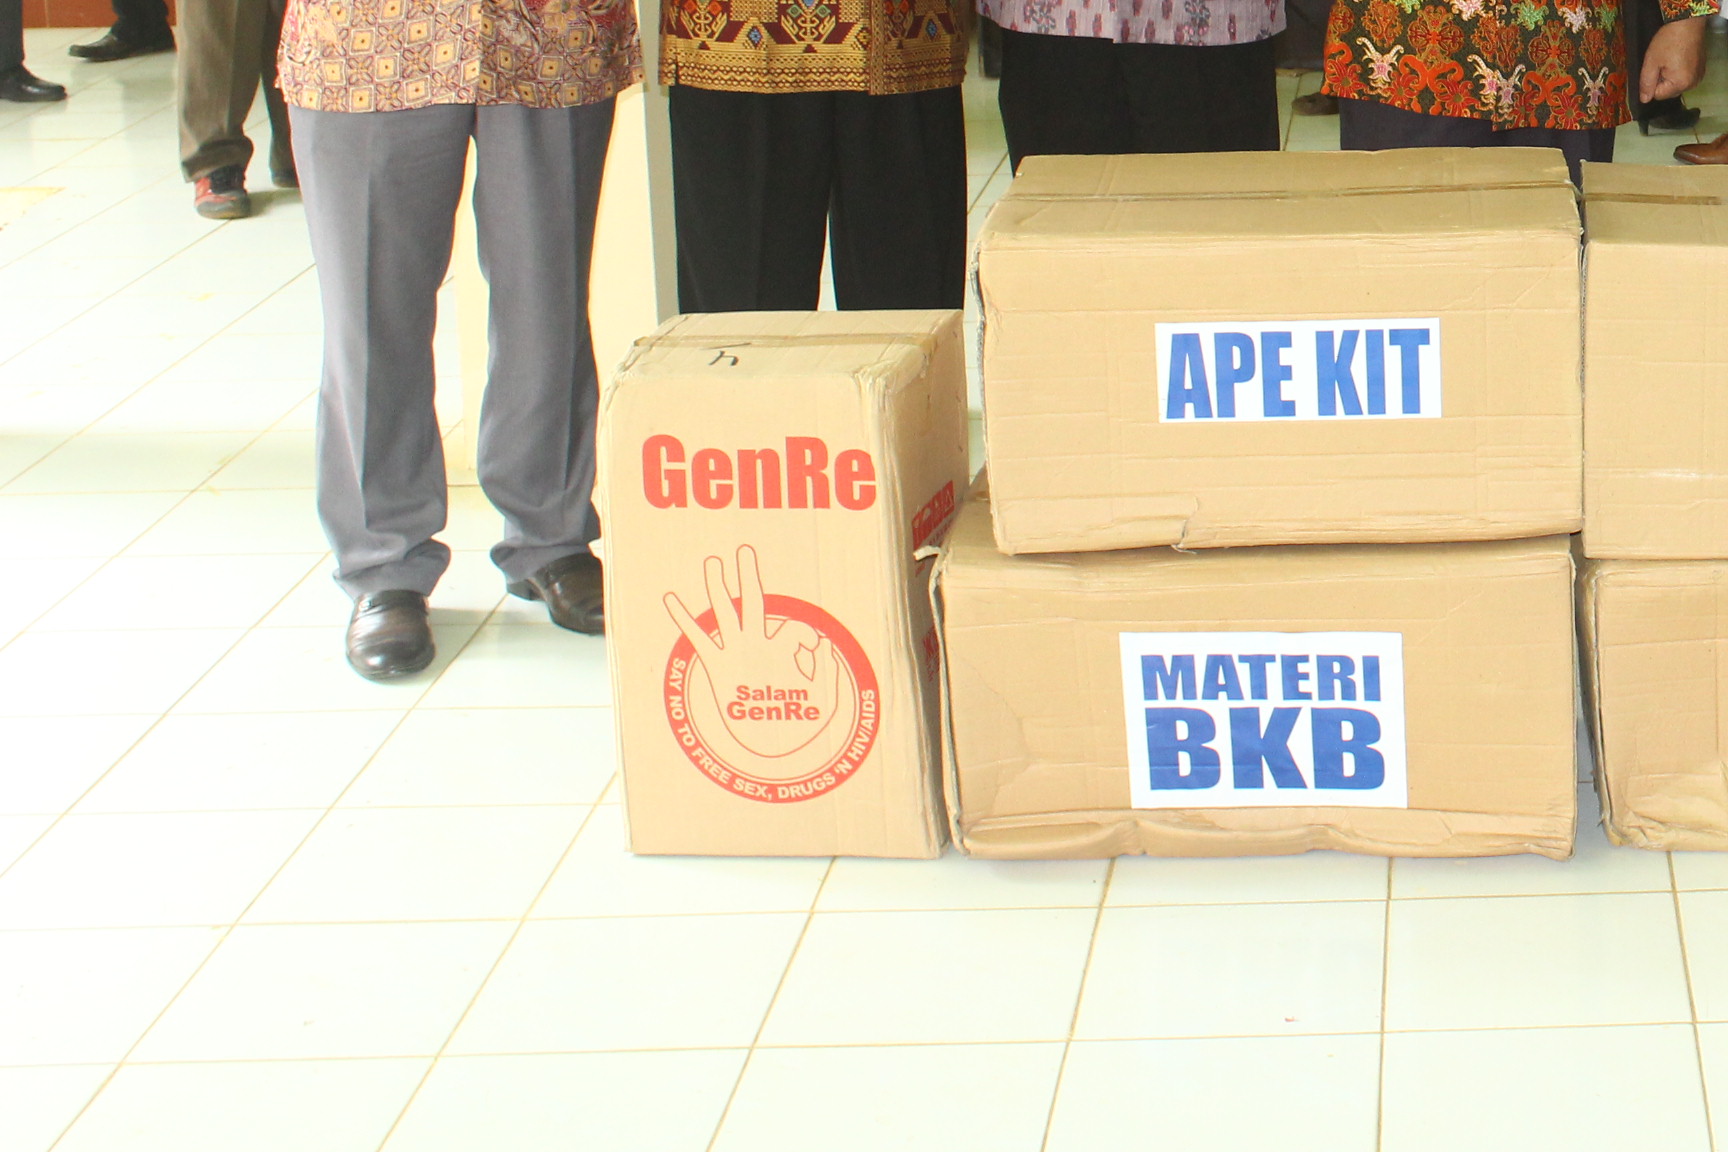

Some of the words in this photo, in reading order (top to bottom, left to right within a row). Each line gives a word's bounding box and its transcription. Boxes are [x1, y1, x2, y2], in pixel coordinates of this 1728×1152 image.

[1167, 332, 1295, 419] APE
[1316, 329, 1429, 416] KIT
[643, 435, 876, 510] GenRe
[669, 657, 686, 692] SAY
[1141, 655, 1381, 702] MATERI
[669, 696, 685, 721] NO
[736, 685, 808, 701] Salam
[727, 701, 820, 720] GenRe
[847, 689, 875, 762] HIV/AIDS
[677, 723, 696, 747] TO
[1145, 708, 1385, 791] BKB
[692, 750, 731, 784] FREE
[733, 778, 772, 800] SEX,
[778, 773, 836, 799] DRUGS
